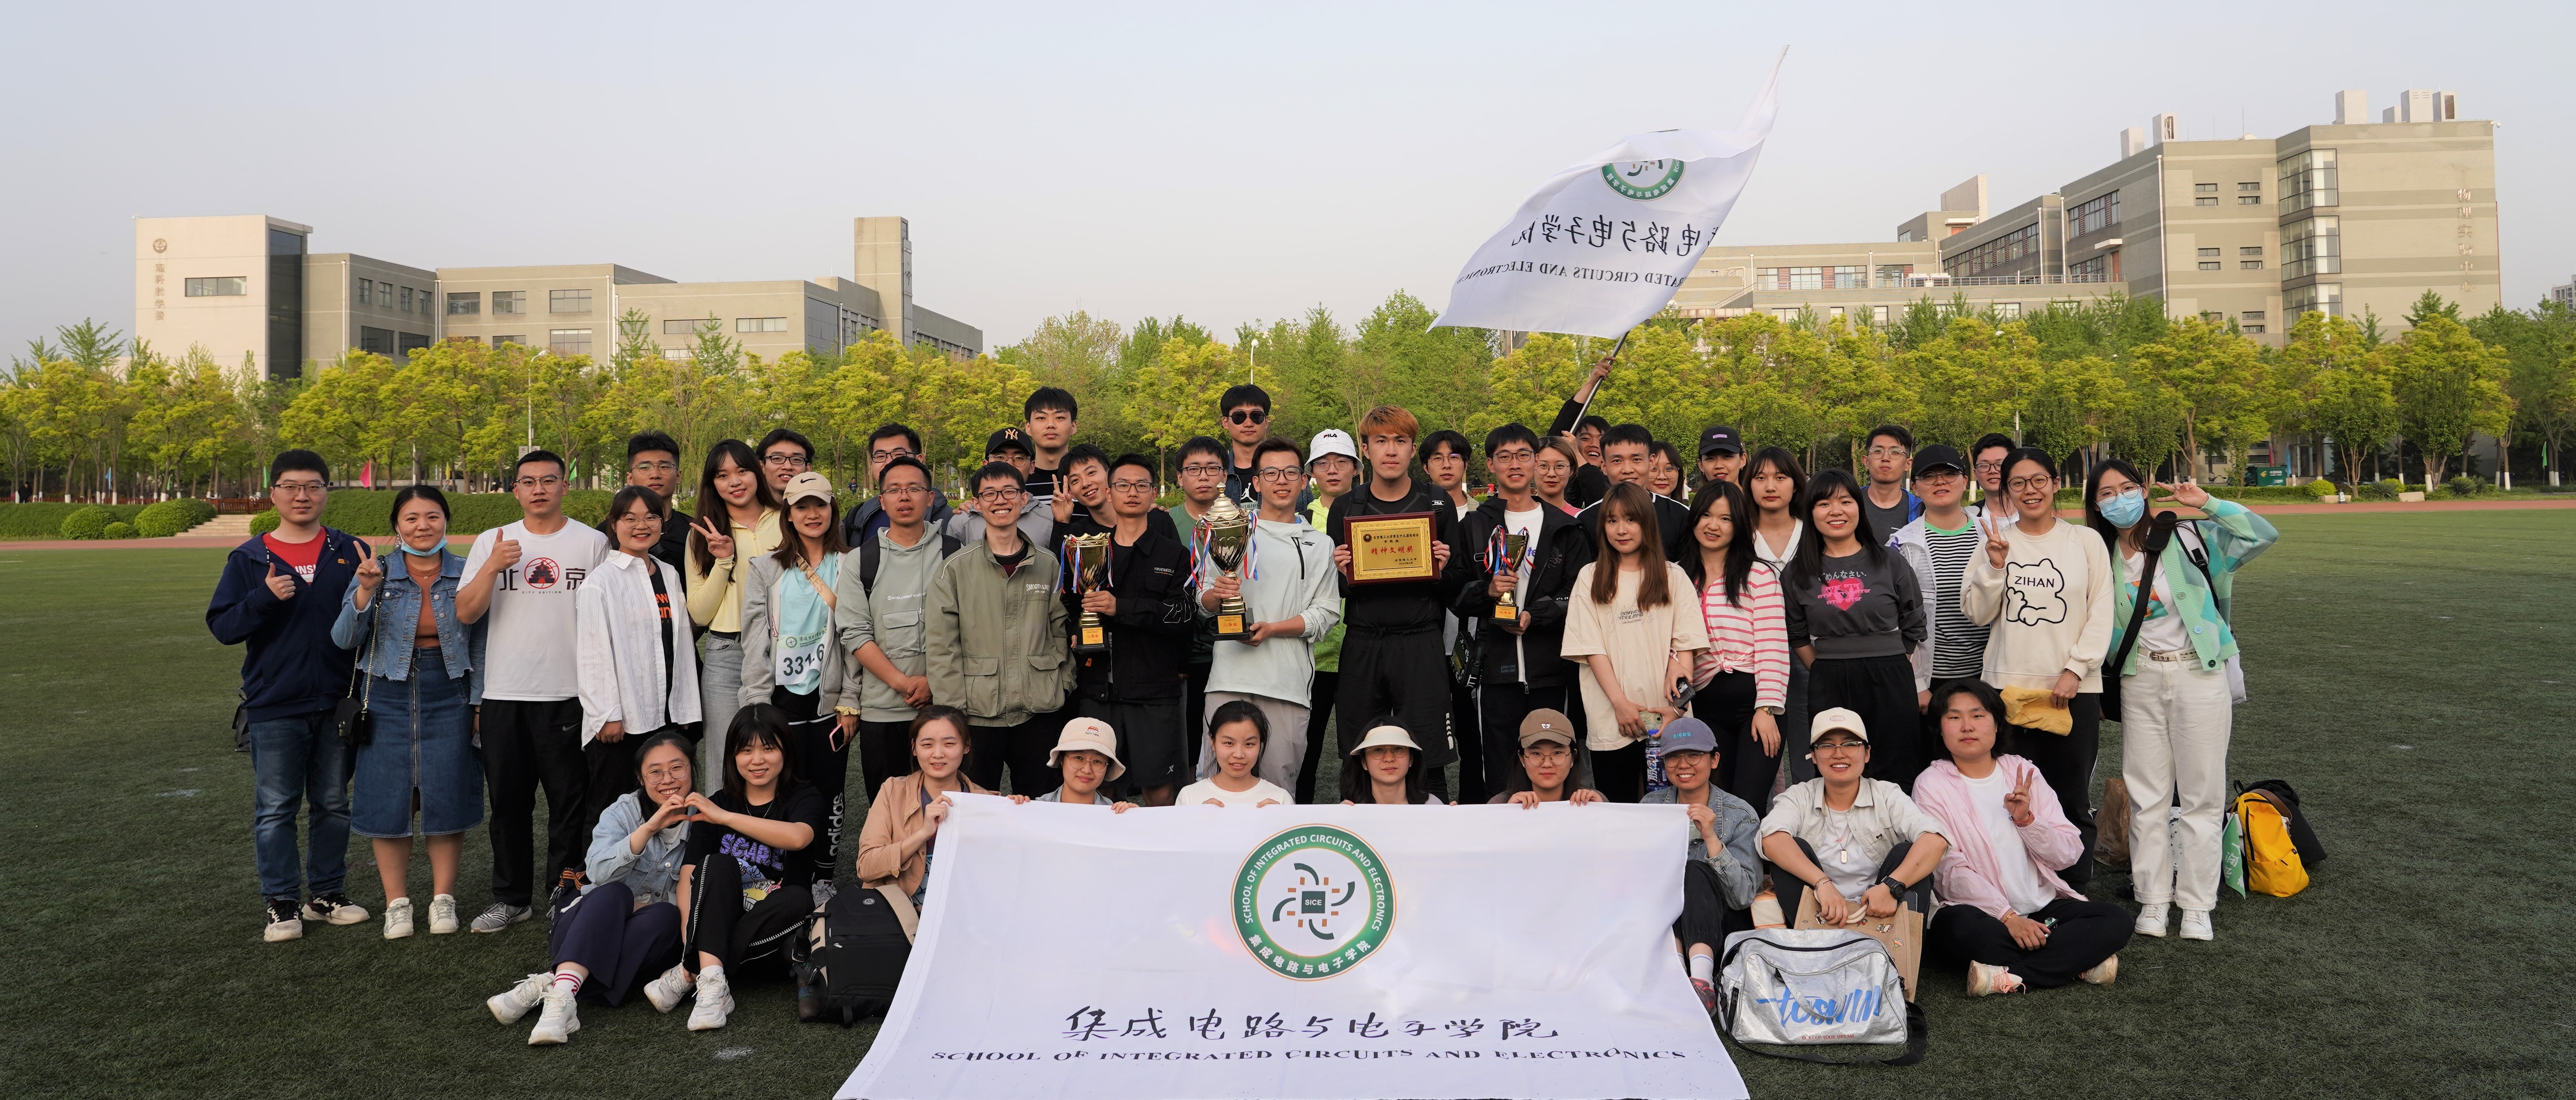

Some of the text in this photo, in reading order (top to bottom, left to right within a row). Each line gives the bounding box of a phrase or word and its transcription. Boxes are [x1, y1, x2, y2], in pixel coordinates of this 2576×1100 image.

[2457, 188, 2475, 292] 物理实验中心
[155, 264, 166, 321] 理科教学楼
[1005, 428, 1018, 440] NY
[1370, 545, 1413, 555] 精神文明奖
[498, 568, 586, 591] 北 京
[2015, 576, 2054, 588] ZIHAN
[828, 792, 843, 856] adidas
[1242, 834, 1385, 931] SCHOOL OF INTEGRATED CIRCUITS AND ELECTRONICS
[1248, 933, 1371, 974] 集成电路与电子学院
[1062, 1006, 1558, 1041] 集成电路与电子学院
[931, 1052, 1041, 1061] SCHOOL
[1053, 1051, 1089, 1060] OF
[1100, 1051, 1272, 1060] INTEGRATED
[1285, 1049, 1413, 1059] CIRCUITS
[1495, 1047, 1686, 1059] ELECTRONICS
